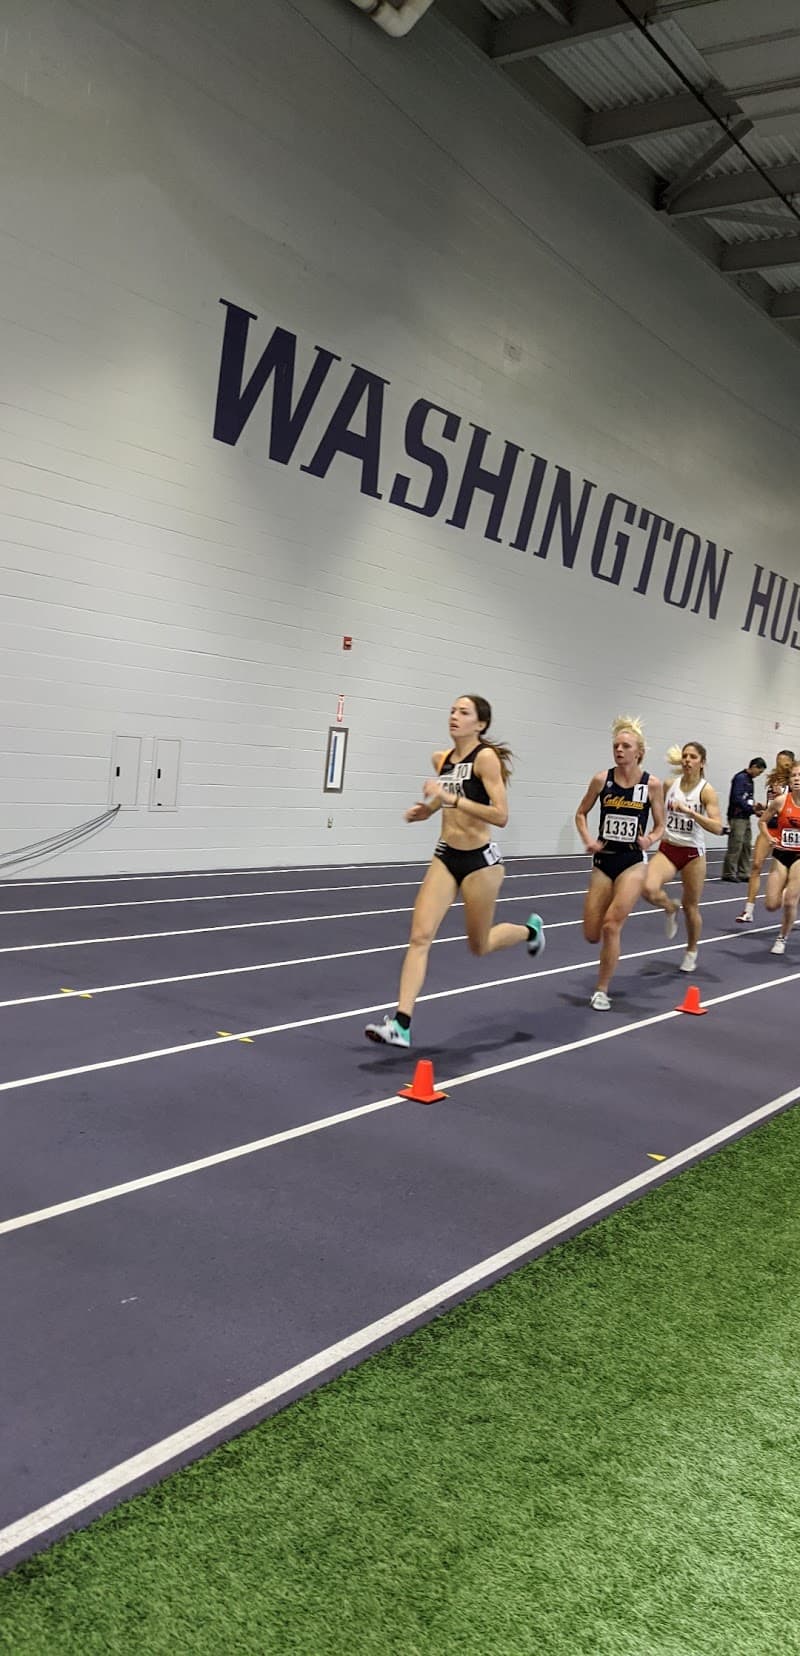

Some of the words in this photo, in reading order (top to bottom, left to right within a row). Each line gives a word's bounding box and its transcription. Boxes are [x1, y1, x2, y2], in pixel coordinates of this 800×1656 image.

[213, 298, 733, 619] WASHINGTON
[456, 764, 469, 779] 10
[637, 785, 645, 801] 1
[603, 793, 645, 810] California
[605, 820, 636, 837] 1333
[667, 815, 693, 831] 2119
